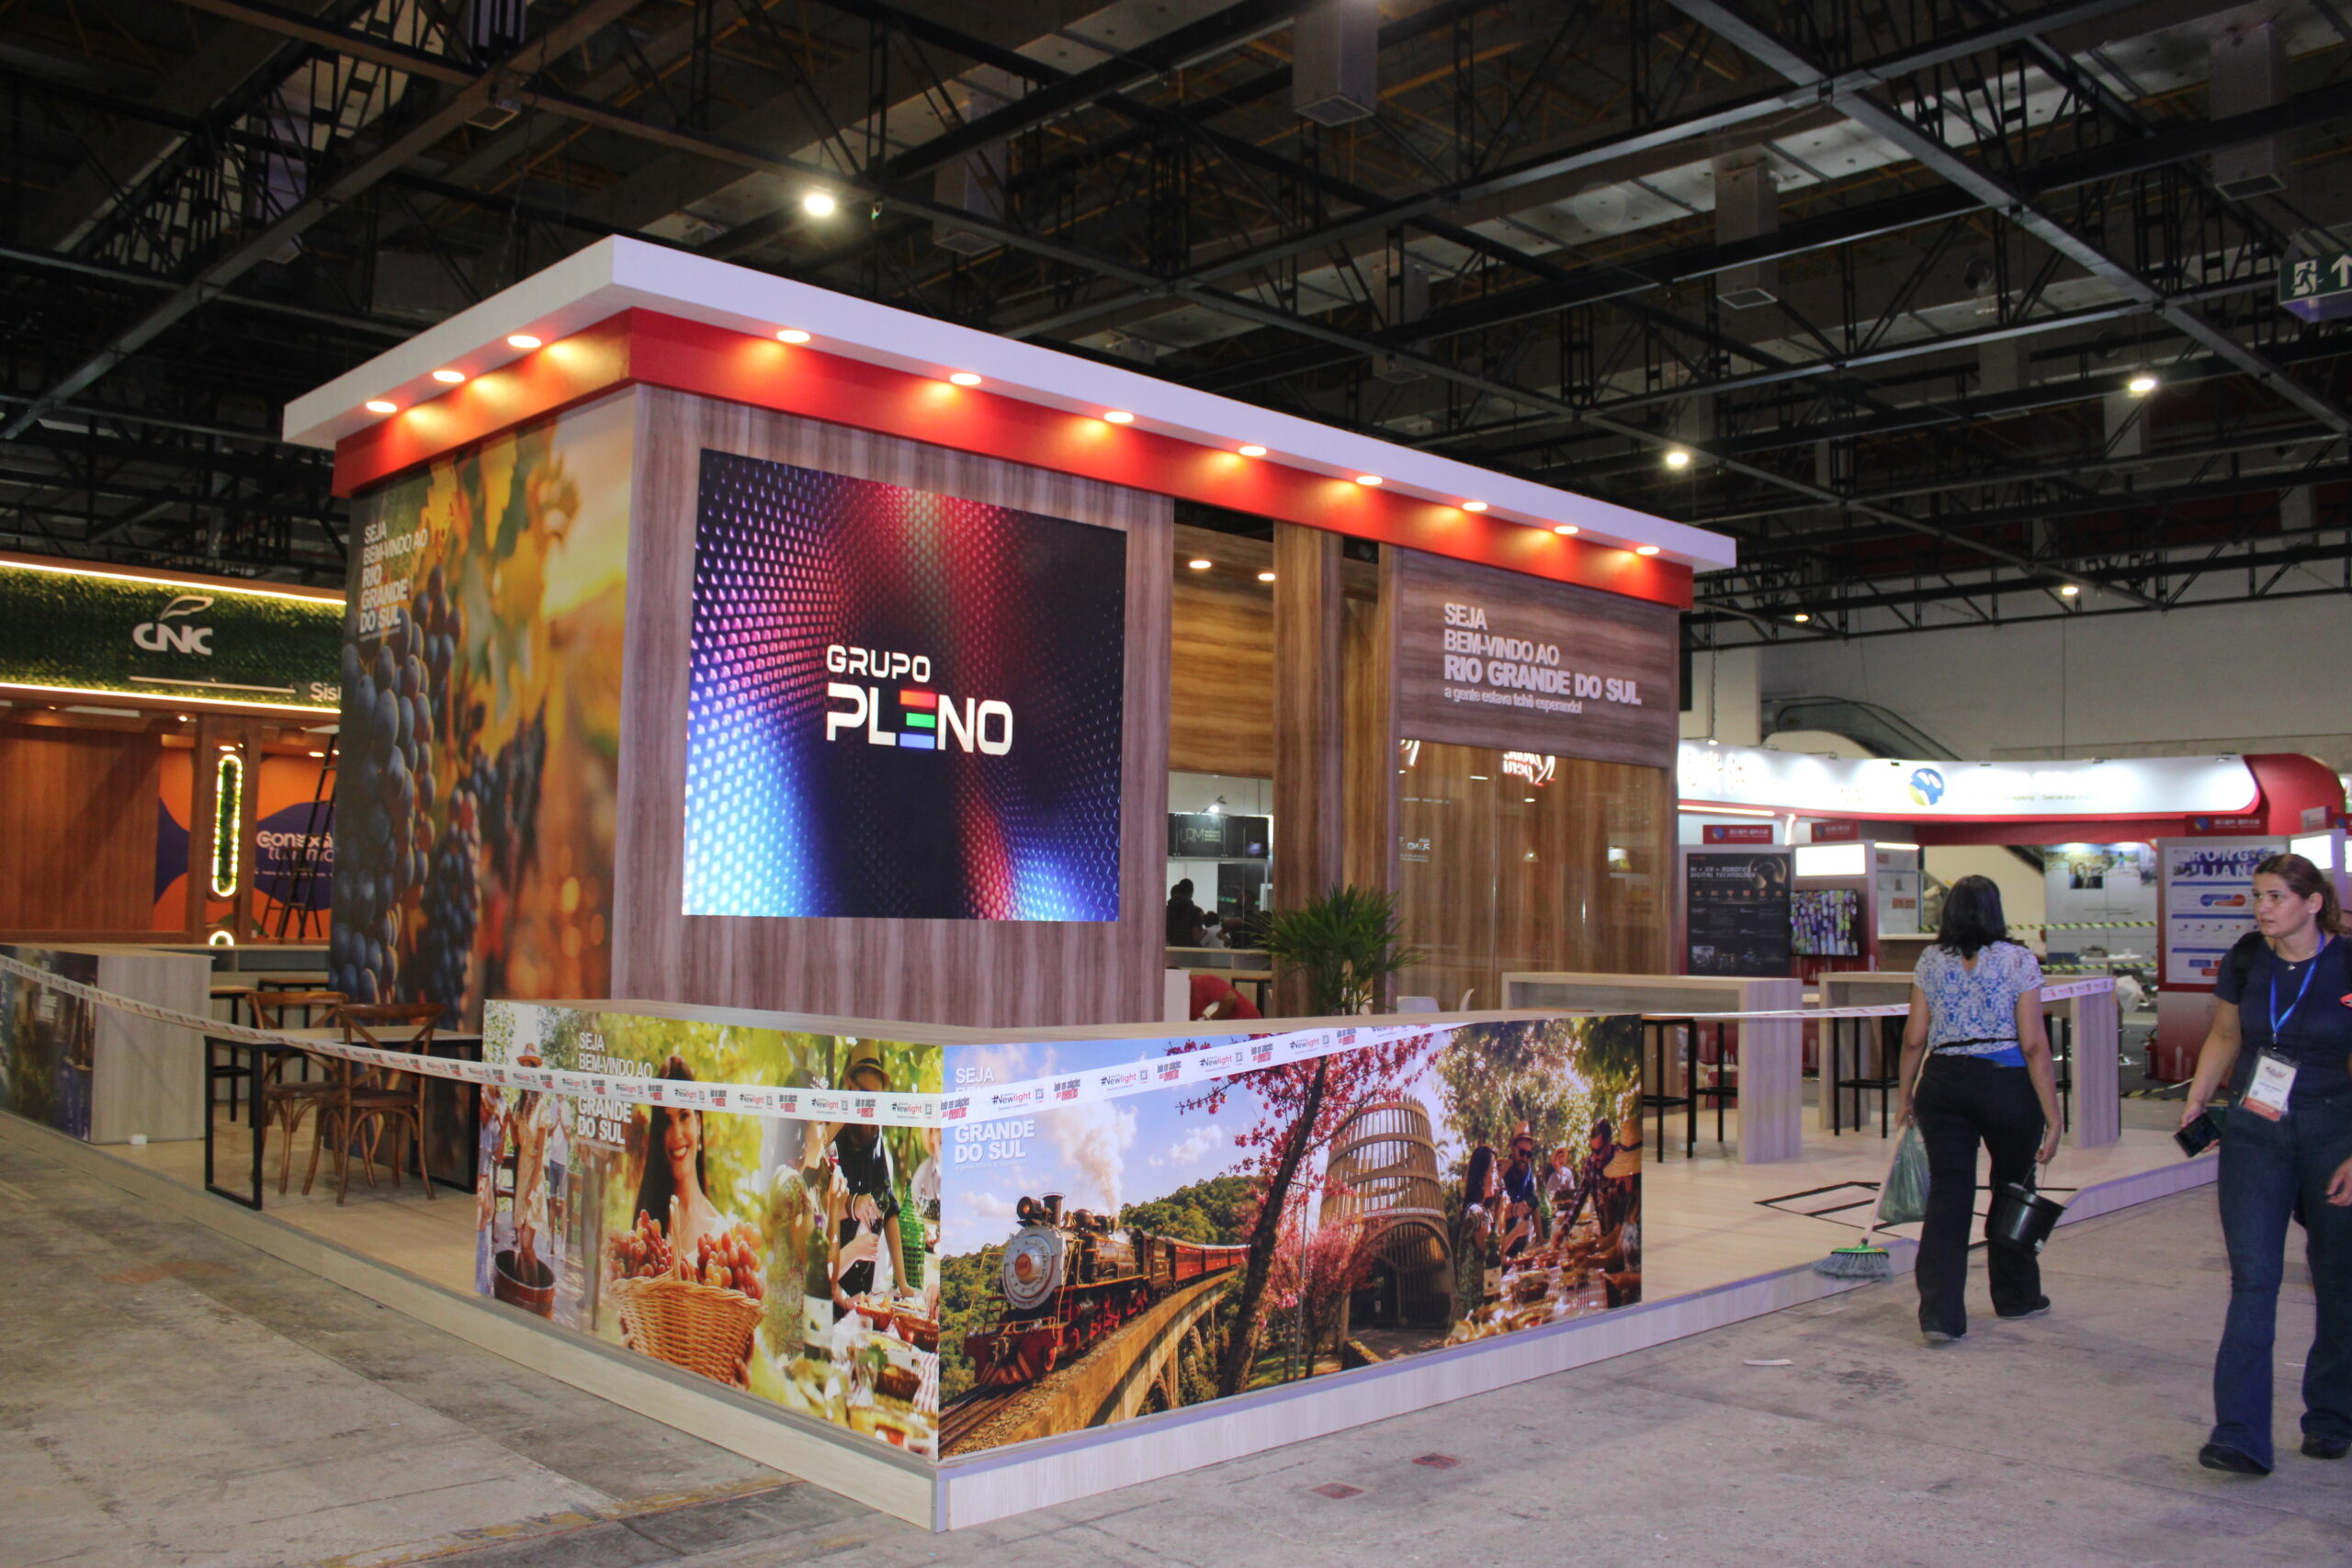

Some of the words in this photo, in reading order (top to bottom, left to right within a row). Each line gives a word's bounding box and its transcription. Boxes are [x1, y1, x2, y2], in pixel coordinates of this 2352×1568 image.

[363, 534, 412, 566] BEM-VINDO
[413, 528, 428, 549] AO
[365, 521, 387, 545] SEJA
[362, 564, 383, 588] RIO
[360, 579, 409, 611] GRANDE
[359, 610, 376, 634] DO
[378, 604, 401, 628] SUL
[1444, 603, 1488, 631] SEJA
[132, 622, 214, 655] CNC
[1444, 628, 1533, 662] BEM-VINDO
[1535, 644, 1560, 666] AO
[827, 644, 931, 682] GRUPO
[1444, 654, 1483, 683] RIO
[1487, 660, 1570, 694] GRANDE
[1575, 673, 1602, 699] DO
[1606, 678, 1642, 705] SUL
[1444, 687, 1452, 698] a
[1453, 687, 1480, 703] gente
[1482, 691, 1511, 705] estava
[826, 682, 1013, 756] PLENO
[579, 1032, 605, 1052] SEJA
[579, 1053, 635, 1077] BEM-VINDO
[636, 1062, 653, 1078] AO
[956, 1066, 995, 1084] SEJA
[578, 1097, 632, 1123] GRANDE
[577, 1115, 596, 1138] DO
[599, 1120, 626, 1145] SUL
[955, 1120, 1035, 1144] GRANDE
[956, 1143, 983, 1164] DO
[989, 1139, 1026, 1160] SUL
